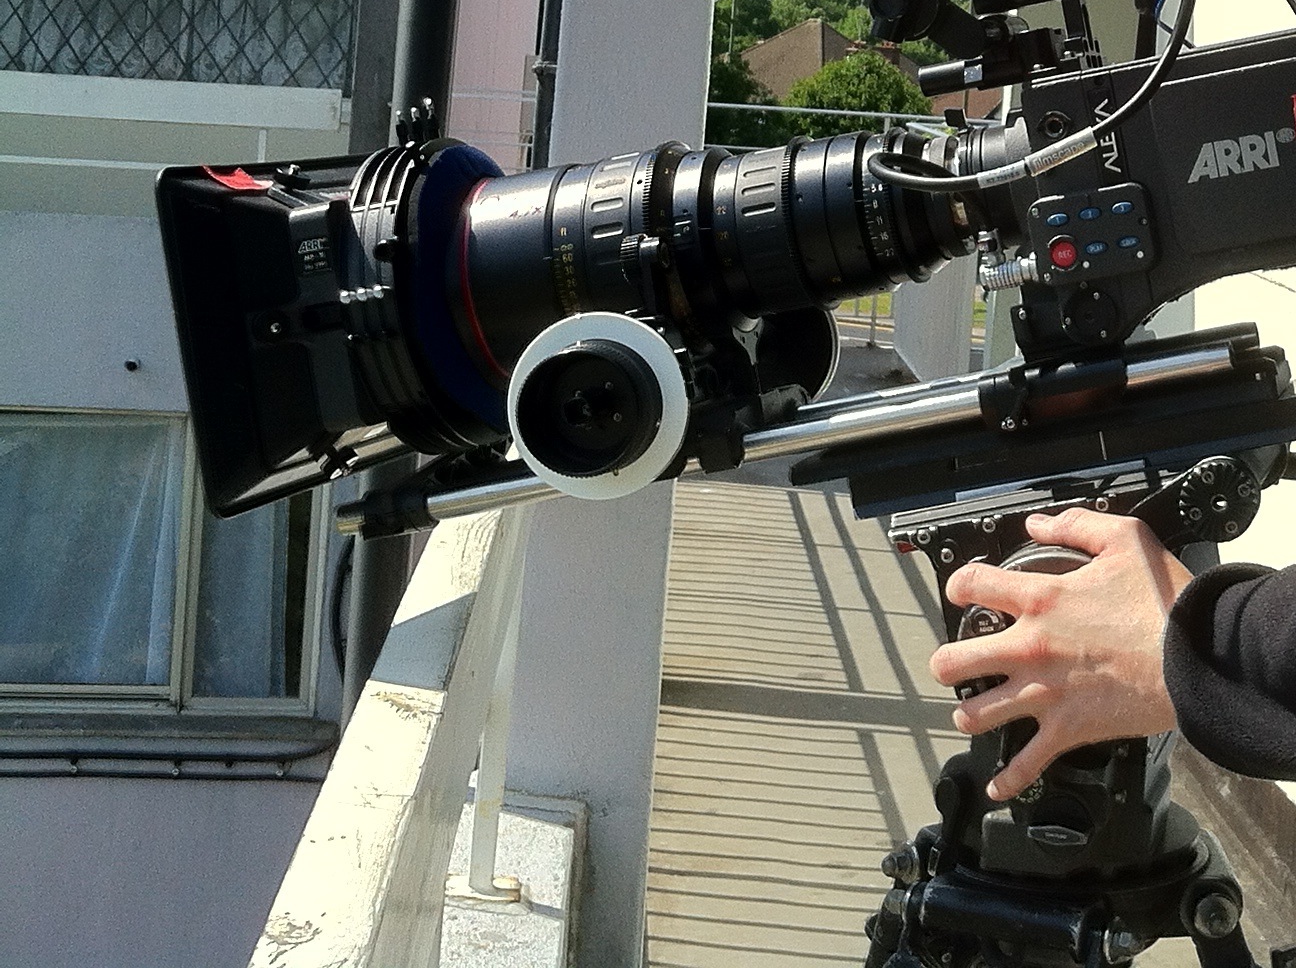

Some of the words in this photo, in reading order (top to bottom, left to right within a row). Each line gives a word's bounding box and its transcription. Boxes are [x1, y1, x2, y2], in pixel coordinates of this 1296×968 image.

[1031, 140, 1085, 170] filmscape
[1187, 131, 1280, 183] ARRI
[1057, 249, 1072, 260] REC
